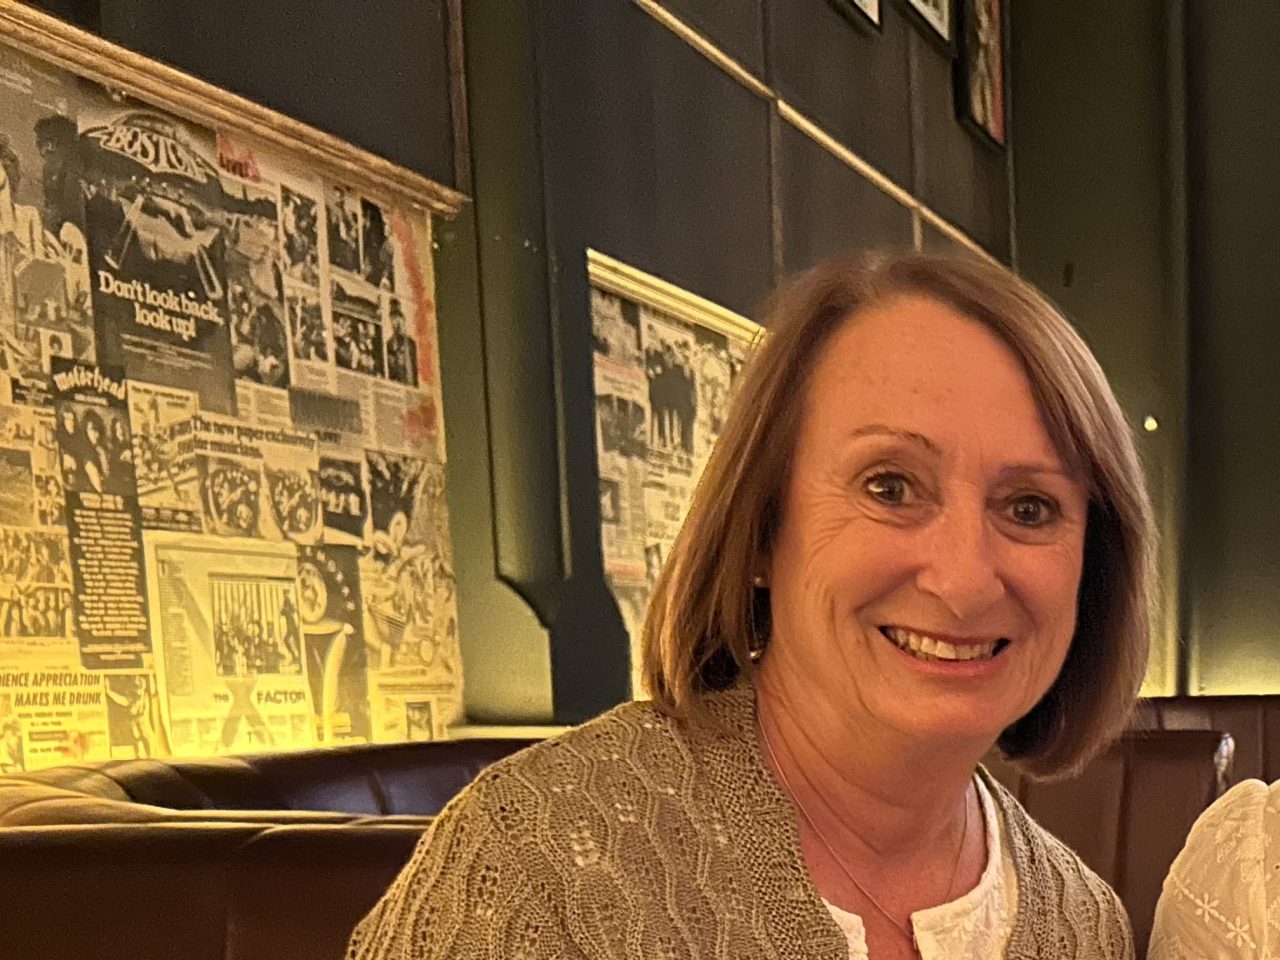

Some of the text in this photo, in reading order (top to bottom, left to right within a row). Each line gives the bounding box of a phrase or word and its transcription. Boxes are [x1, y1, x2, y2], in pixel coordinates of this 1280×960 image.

[103, 125, 208, 184] BOSTON
[98, 271, 225, 326] Don't look back,
[134, 302, 197, 341] look up!
[15, 691, 101, 707] MAKES ME DRUNK
[32, 673, 101, 687] APPRECIATION
